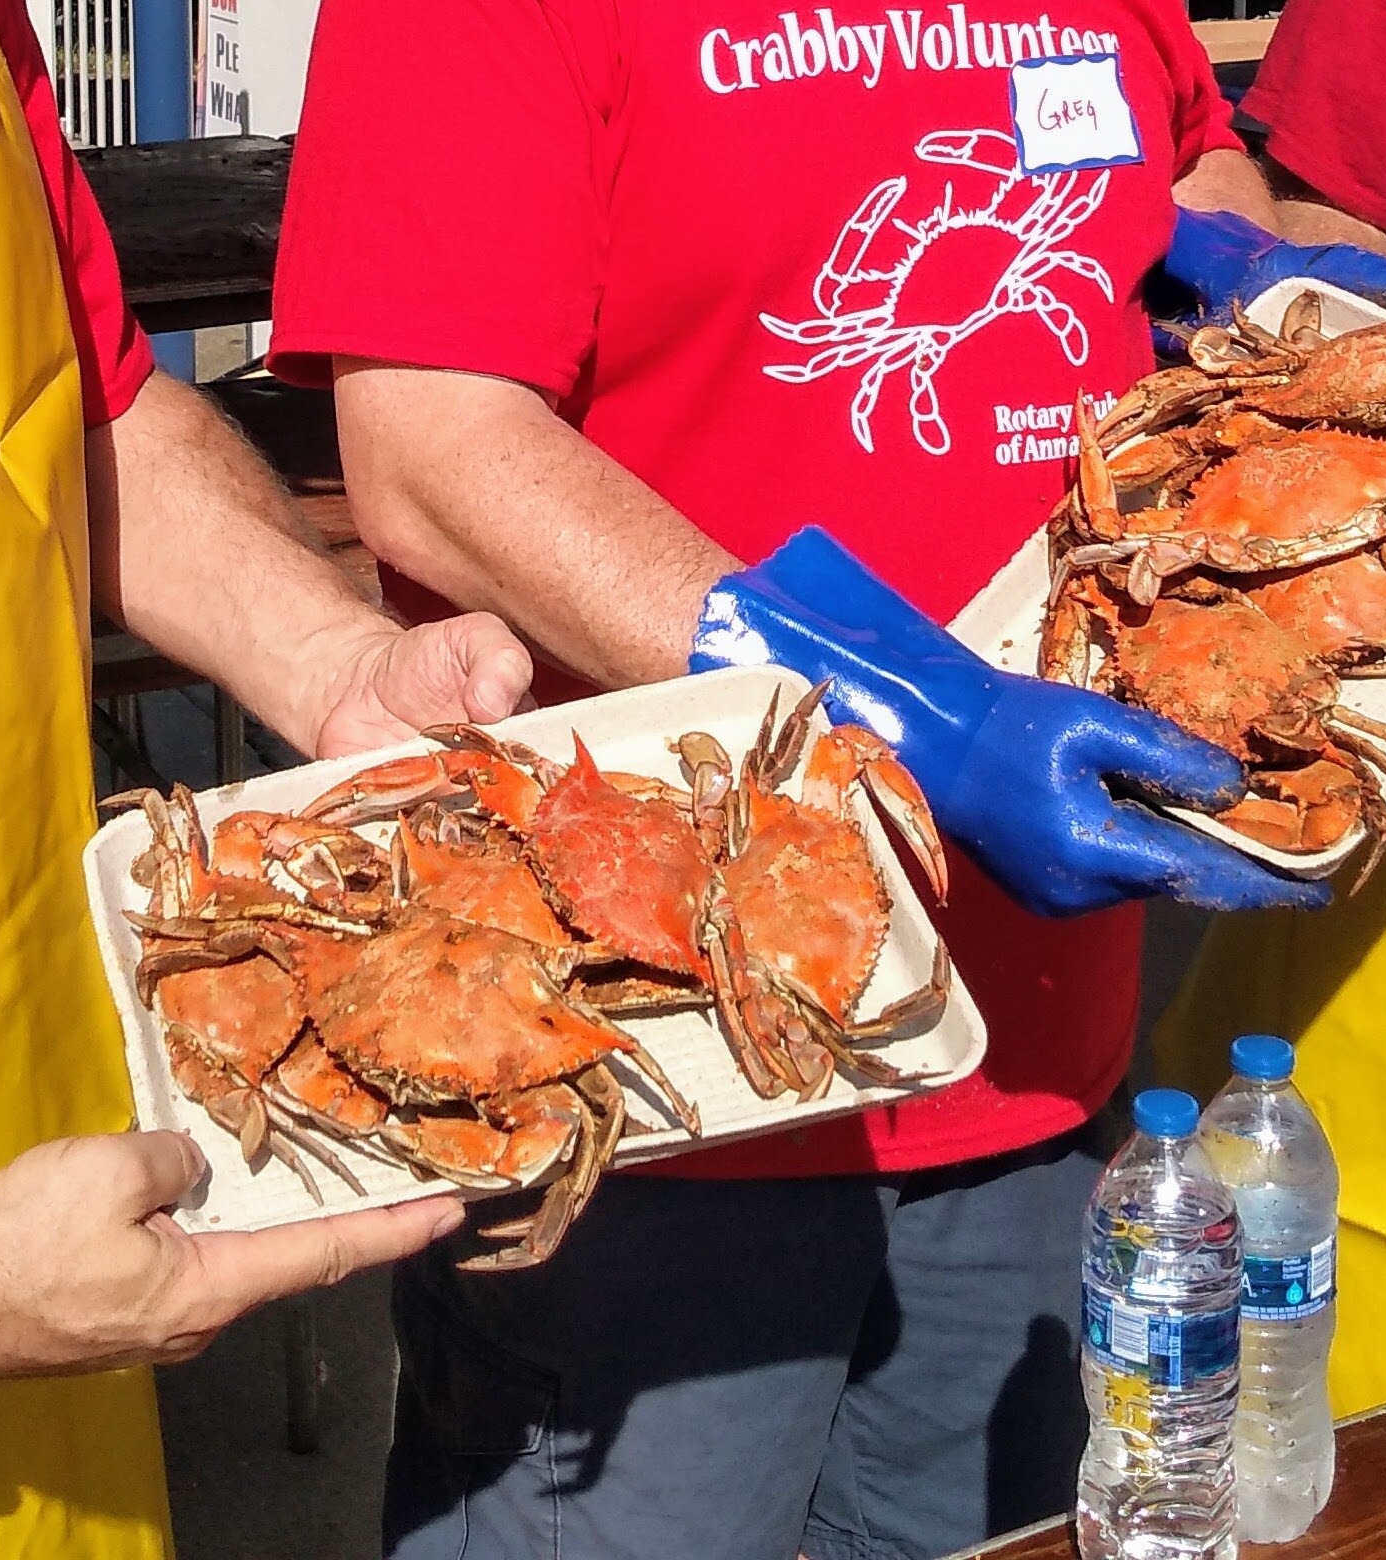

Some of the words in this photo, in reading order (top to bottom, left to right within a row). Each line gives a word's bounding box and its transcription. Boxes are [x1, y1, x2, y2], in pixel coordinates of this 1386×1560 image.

[215, 33, 240, 74] PLE
[210, 81, 242, 123] WHA
[993, 403, 1074, 434] Rotary
[995, 433, 1023, 466] of
[1023, 433, 1081, 463] Anna
